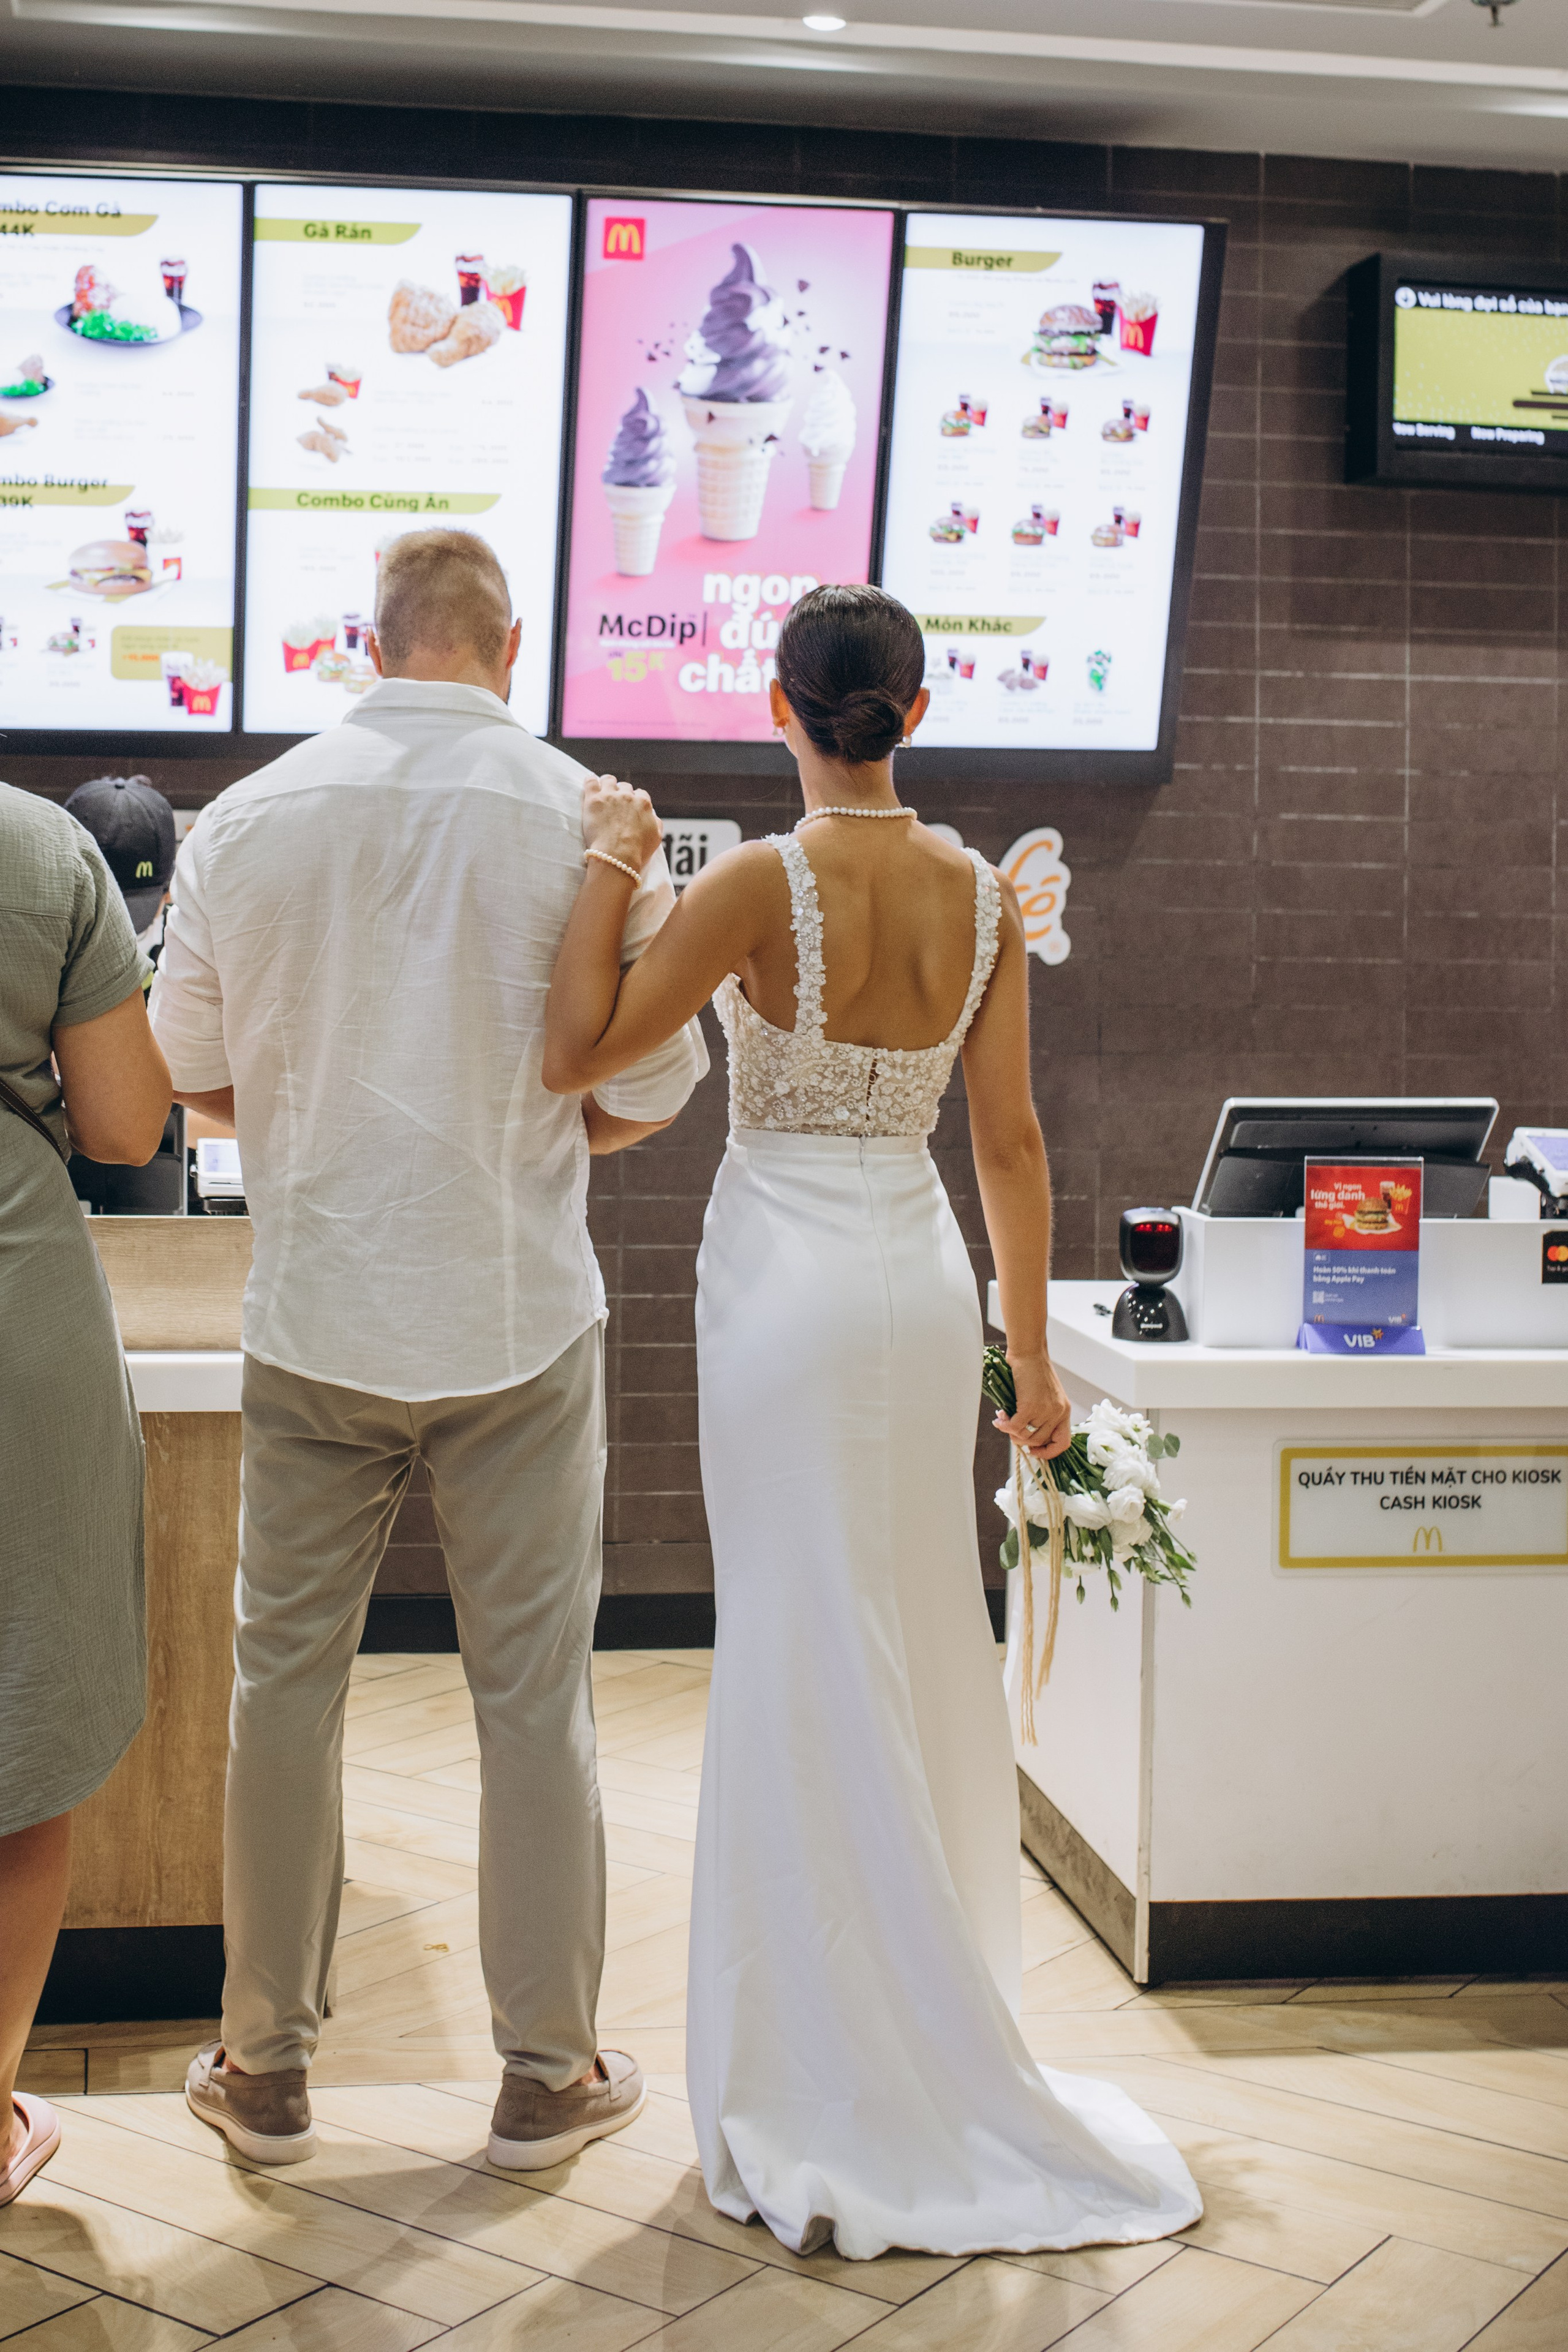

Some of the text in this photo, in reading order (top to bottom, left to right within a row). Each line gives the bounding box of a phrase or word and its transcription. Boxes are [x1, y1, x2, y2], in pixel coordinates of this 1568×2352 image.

[0, 199, 38, 216] mbo
[952, 251, 1012, 270] Burger
[0, 473, 107, 492] mbo Burger
[297, 493, 364, 508] Combo
[703, 572, 820, 614] ngon
[599, 614, 696, 644] McDip
[720, 610, 781, 650] đú
[925, 617, 1012, 633] Món Khác
[1338, 1191, 1365, 1201] danh
[1352, 1275, 1365, 1284] Pay
[1343, 1333, 1376, 1348] VIB
[1351, 1472, 1384, 1485] THU
[1431, 1466, 1466, 1488] MẶT
[1471, 1471, 1507, 1484] CHO
[1512, 1470, 1562, 1484] KIOSK
[1380, 1495, 1482, 1510] CASH KIOSK
